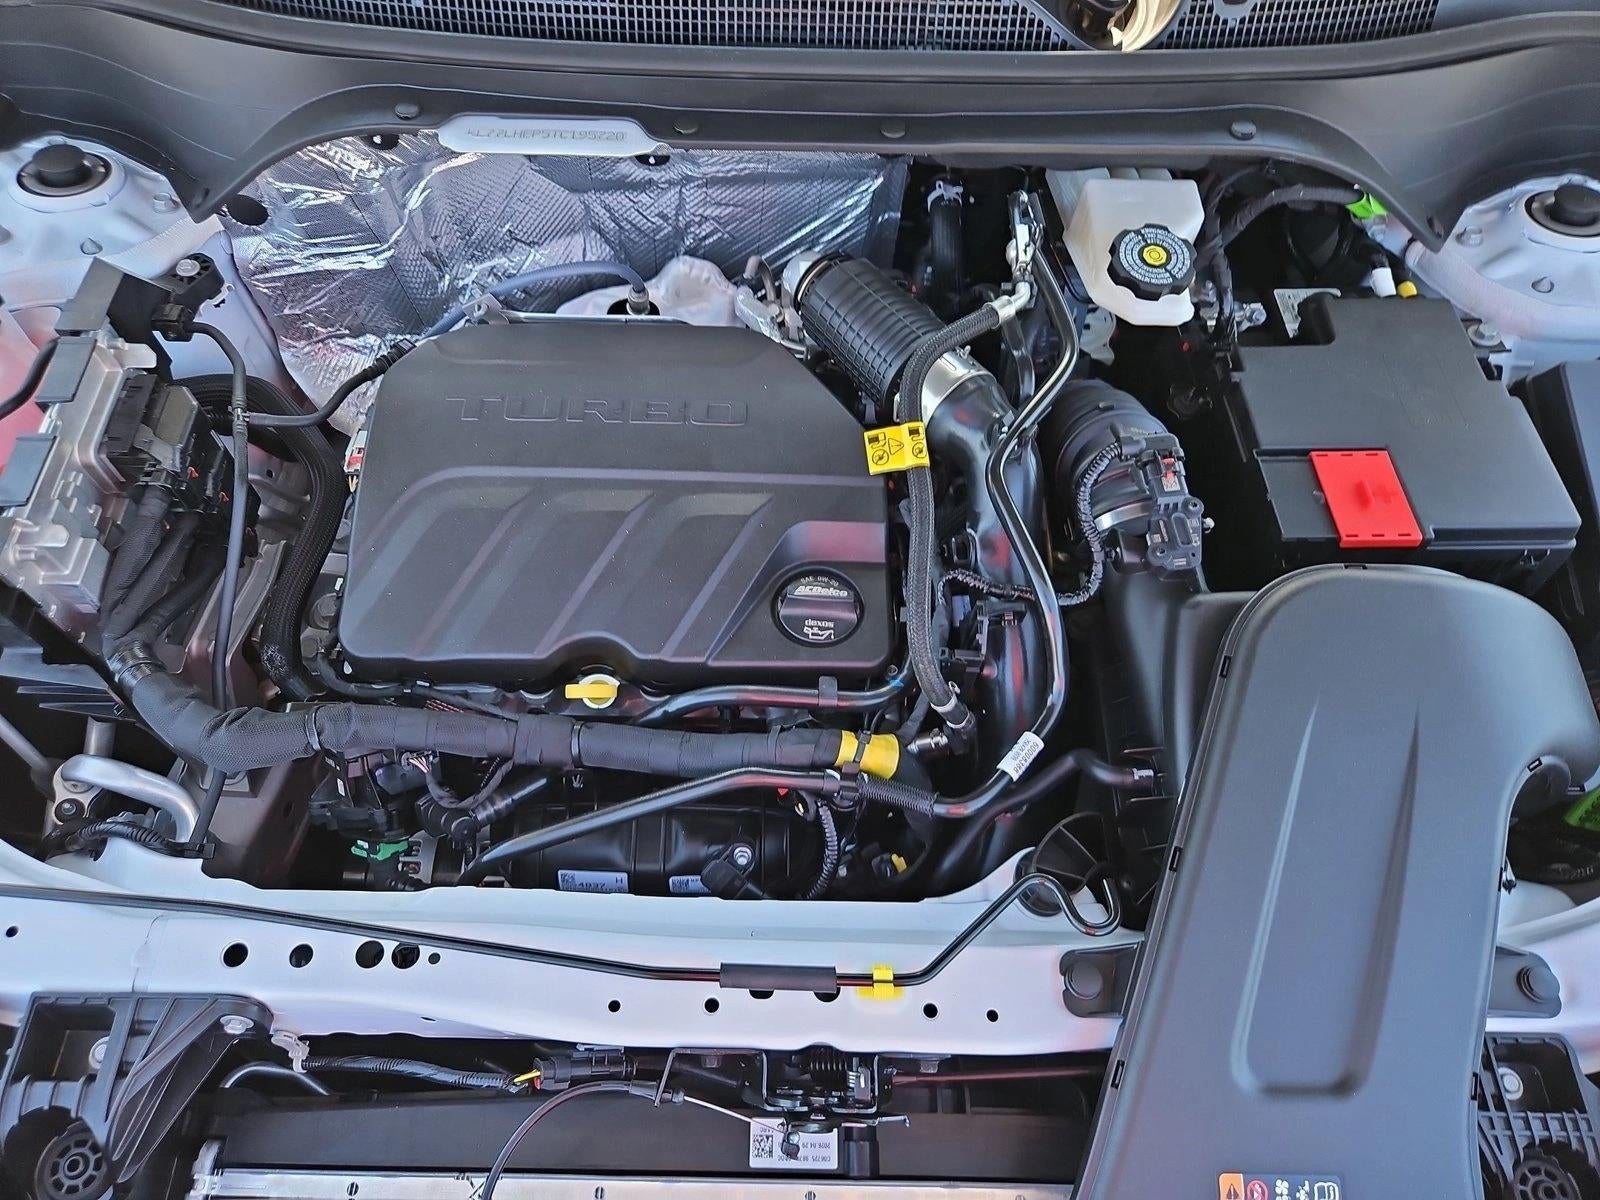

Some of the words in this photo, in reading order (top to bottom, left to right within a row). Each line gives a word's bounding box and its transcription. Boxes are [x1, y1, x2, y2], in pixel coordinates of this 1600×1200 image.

[446, 398, 748, 426] TURBO
[794, 585, 848, 597] ACDelco
[804, 618, 834, 628] dexos
